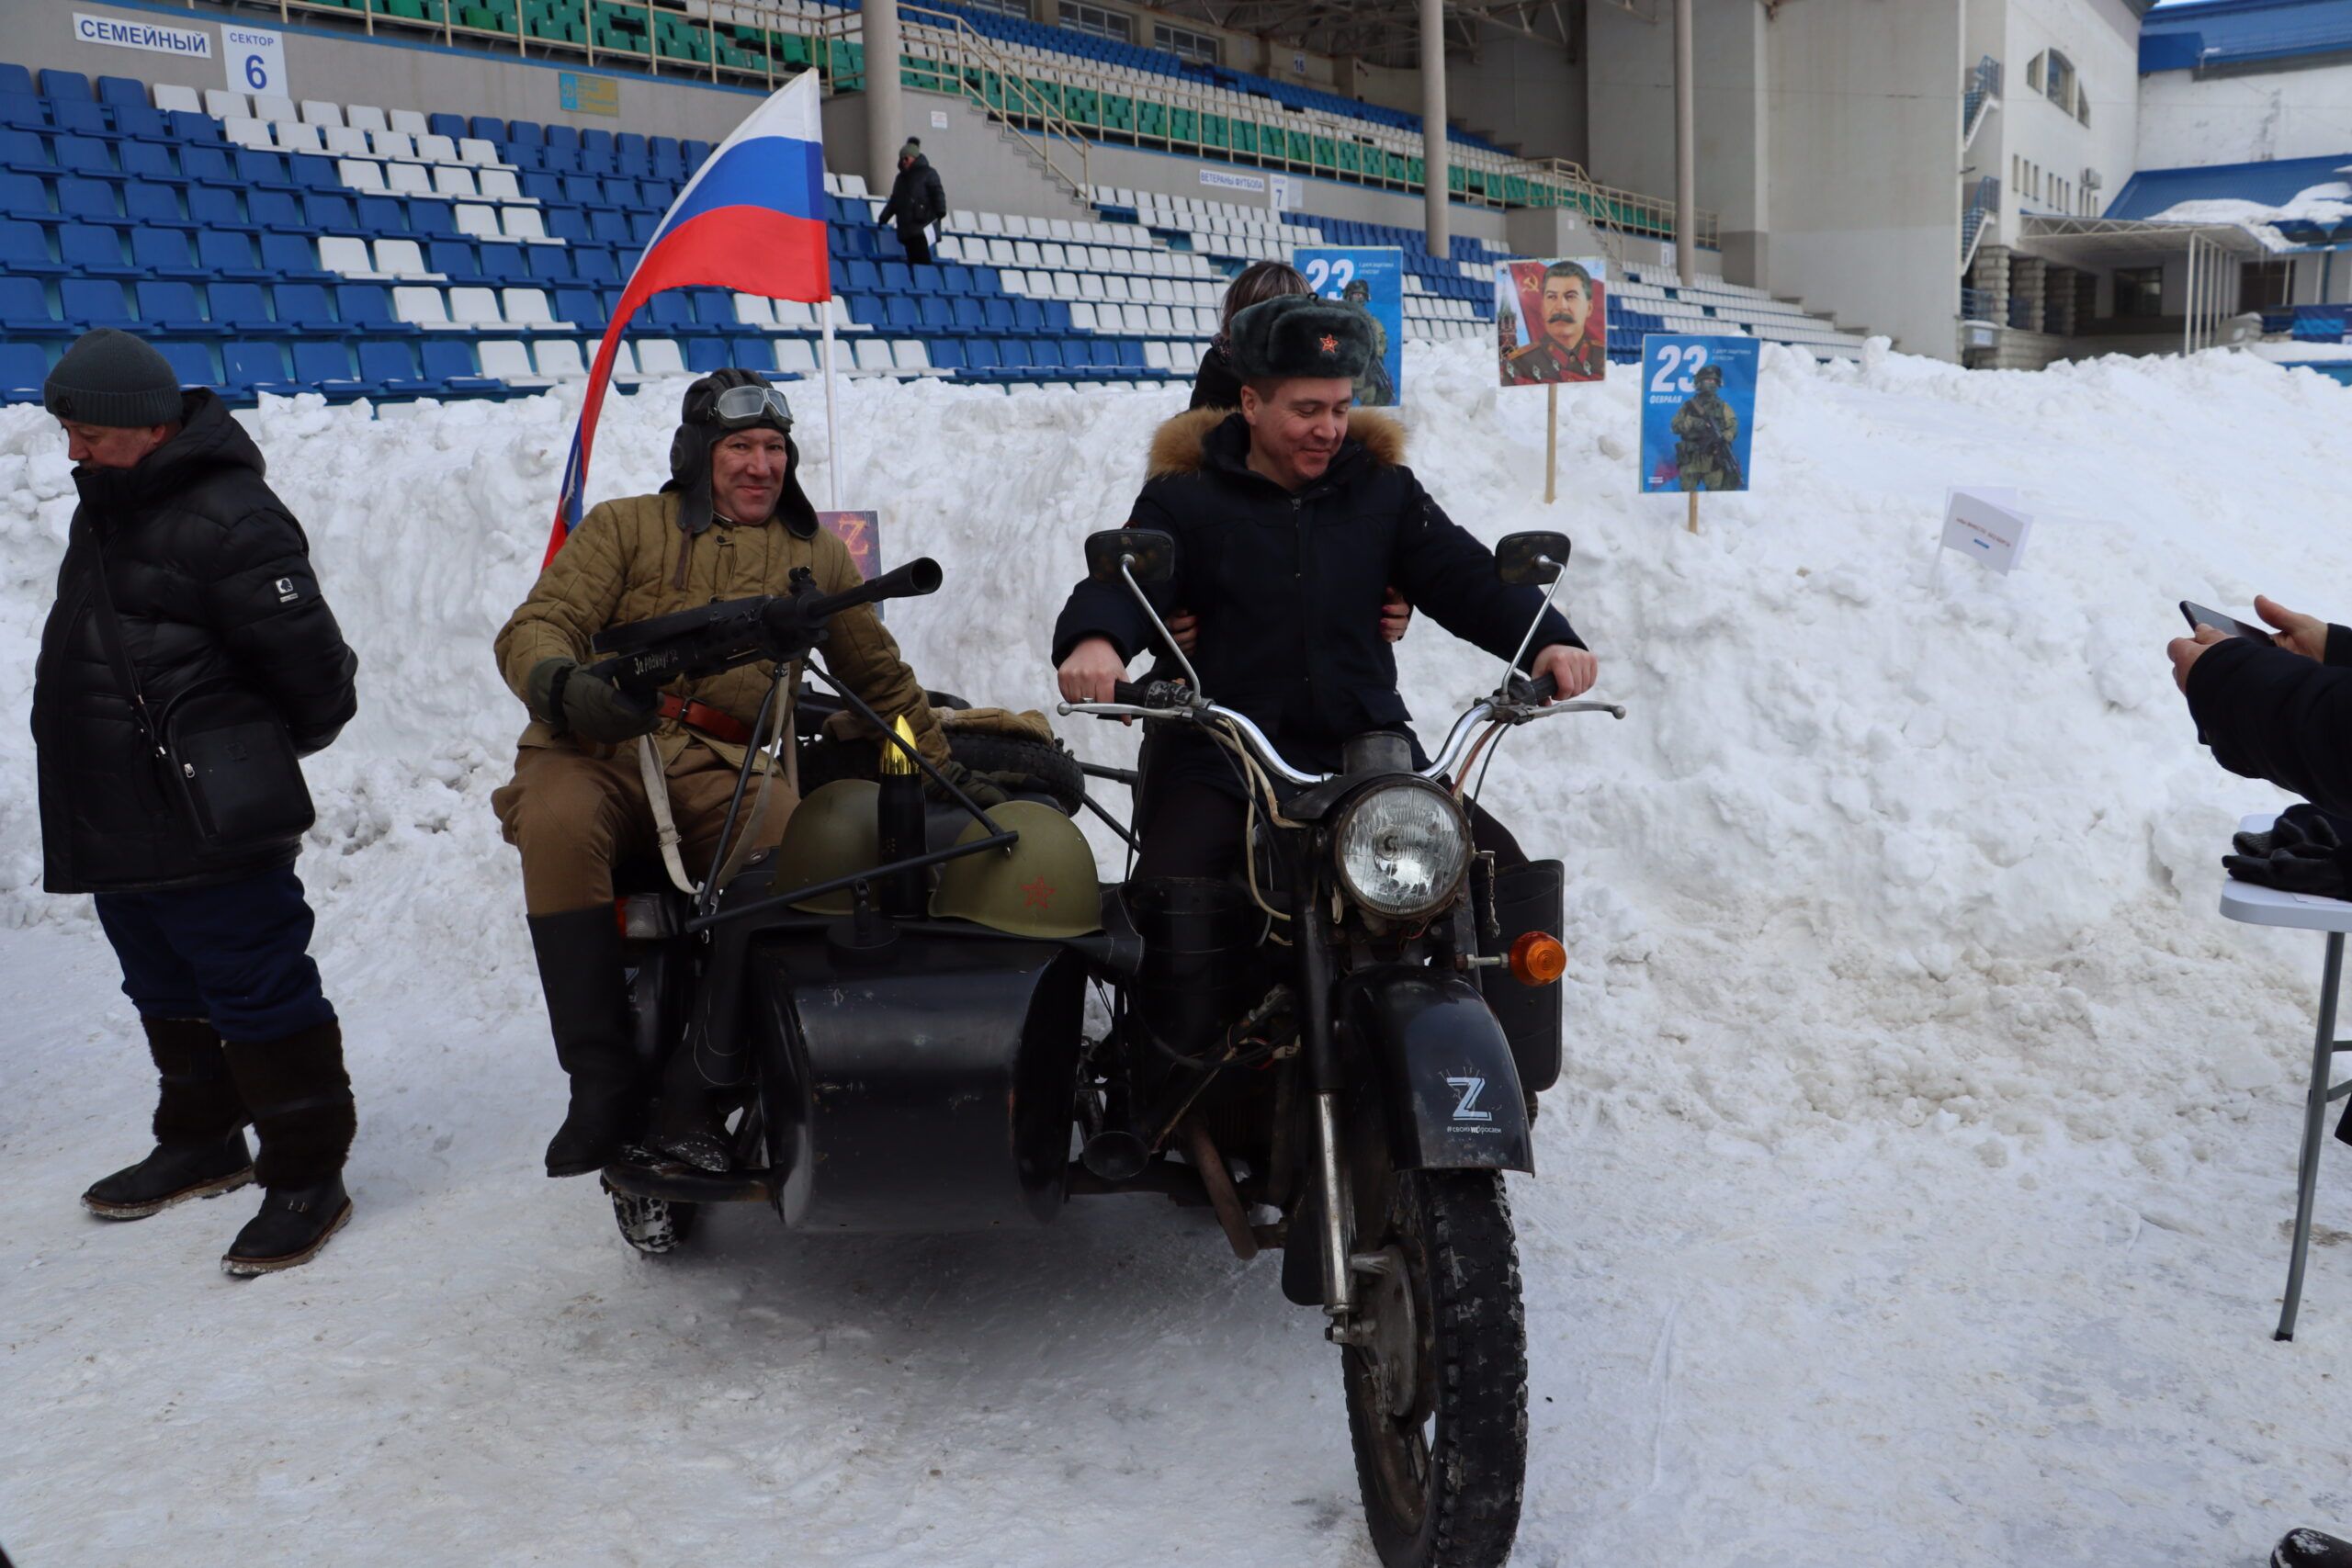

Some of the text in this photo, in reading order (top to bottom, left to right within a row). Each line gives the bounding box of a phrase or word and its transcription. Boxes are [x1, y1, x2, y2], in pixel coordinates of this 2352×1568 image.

[80, 19, 207, 53] СЕМЕЙНЫЙ
[230, 32, 274, 46] СЕКТОР
[244, 54, 267, 90] 6
[1201, 172, 1234, 185] ВЕТЕРАНЫ
[1236, 178, 1263, 189] ФУТБОЛА
[1275, 188, 1283, 208] 7
[1651, 344, 1708, 392] 23
[1649, 395, 1682, 404] ФЕВРАЛЯ
[1446, 1077, 1492, 1121] Z
